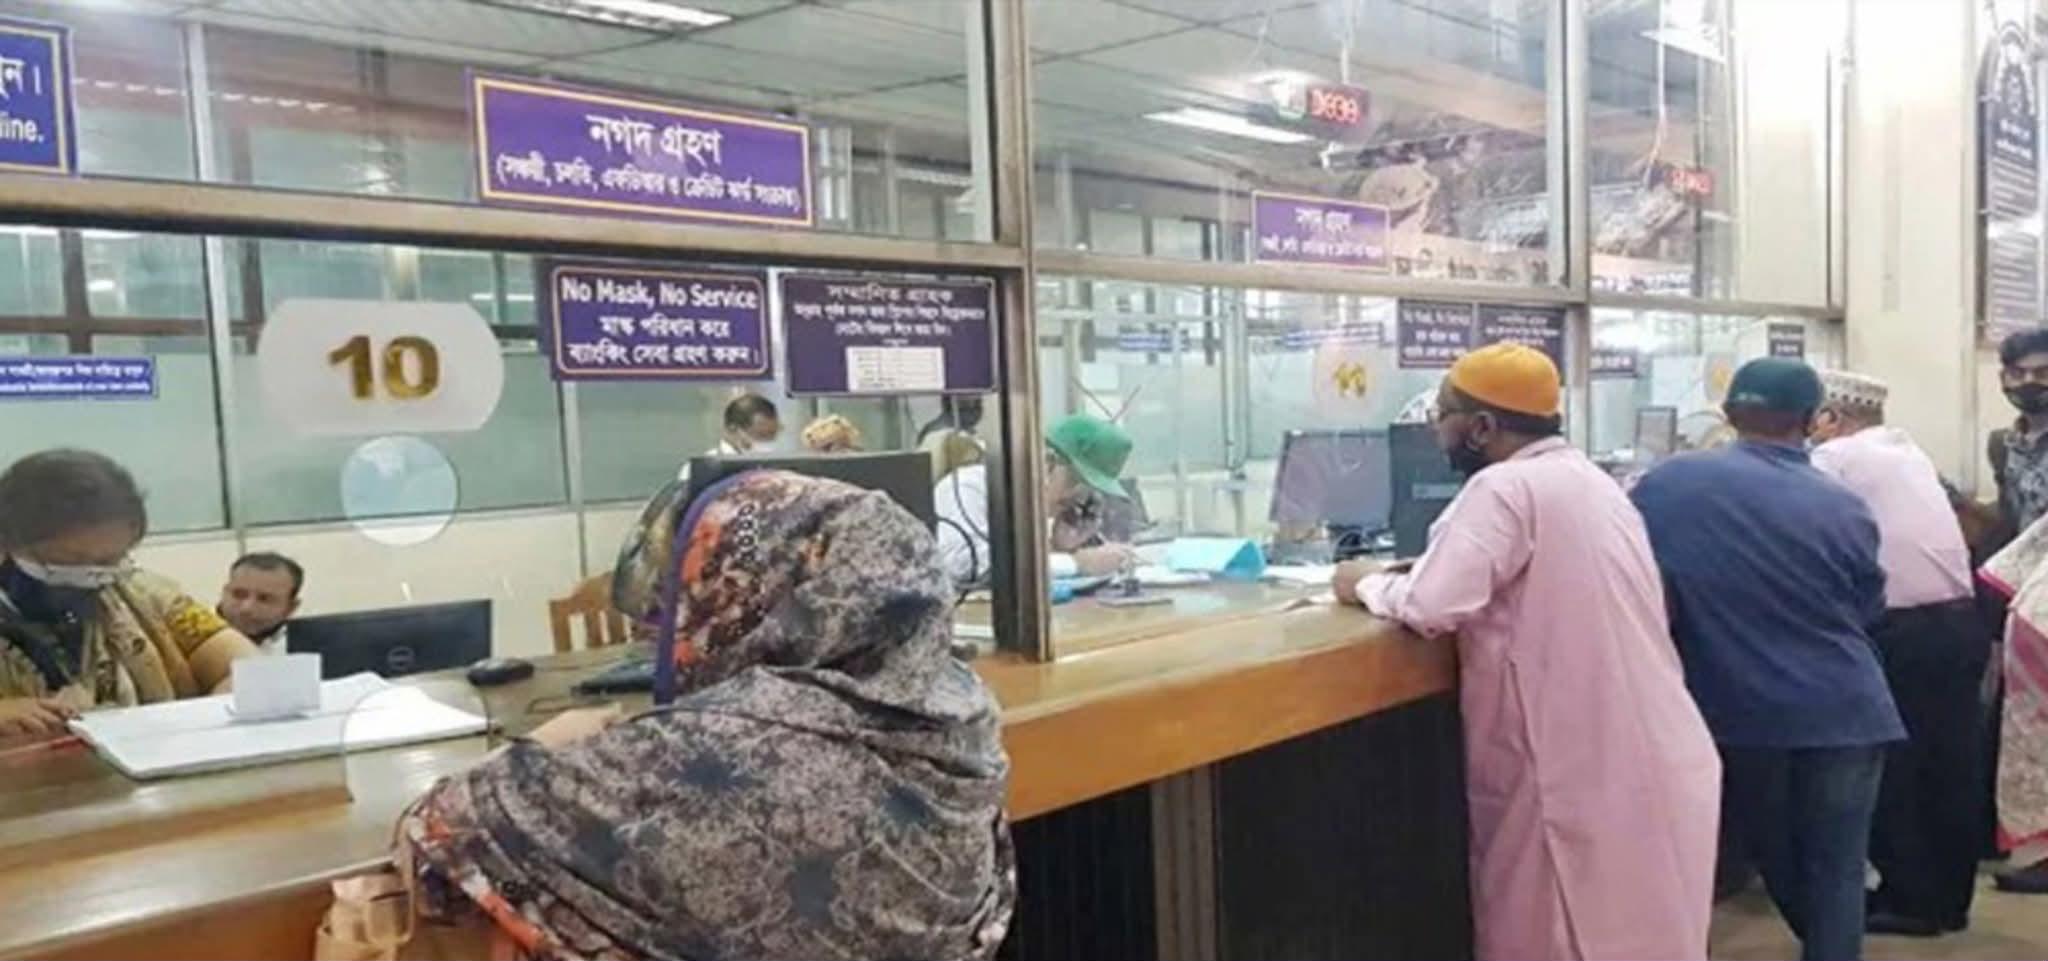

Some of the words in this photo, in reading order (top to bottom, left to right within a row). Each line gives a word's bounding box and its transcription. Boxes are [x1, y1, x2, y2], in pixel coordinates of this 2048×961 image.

[585, 113, 656, 157] নগদ
[659, 122, 724, 168] গ্রহণ
[561, 276, 592, 303] No
[596, 278, 655, 310] Mask,
[659, 282, 688, 307] No
[690, 284, 758, 310] Service
[639, 311, 696, 337] পরিধান
[699, 319, 731, 339] করে
[327, 335, 440, 399] 10
[566, 337, 632, 366] ব্যাংকিং
[633, 344, 670, 365] সেবা
[672, 344, 709, 366] গ্রহণ
